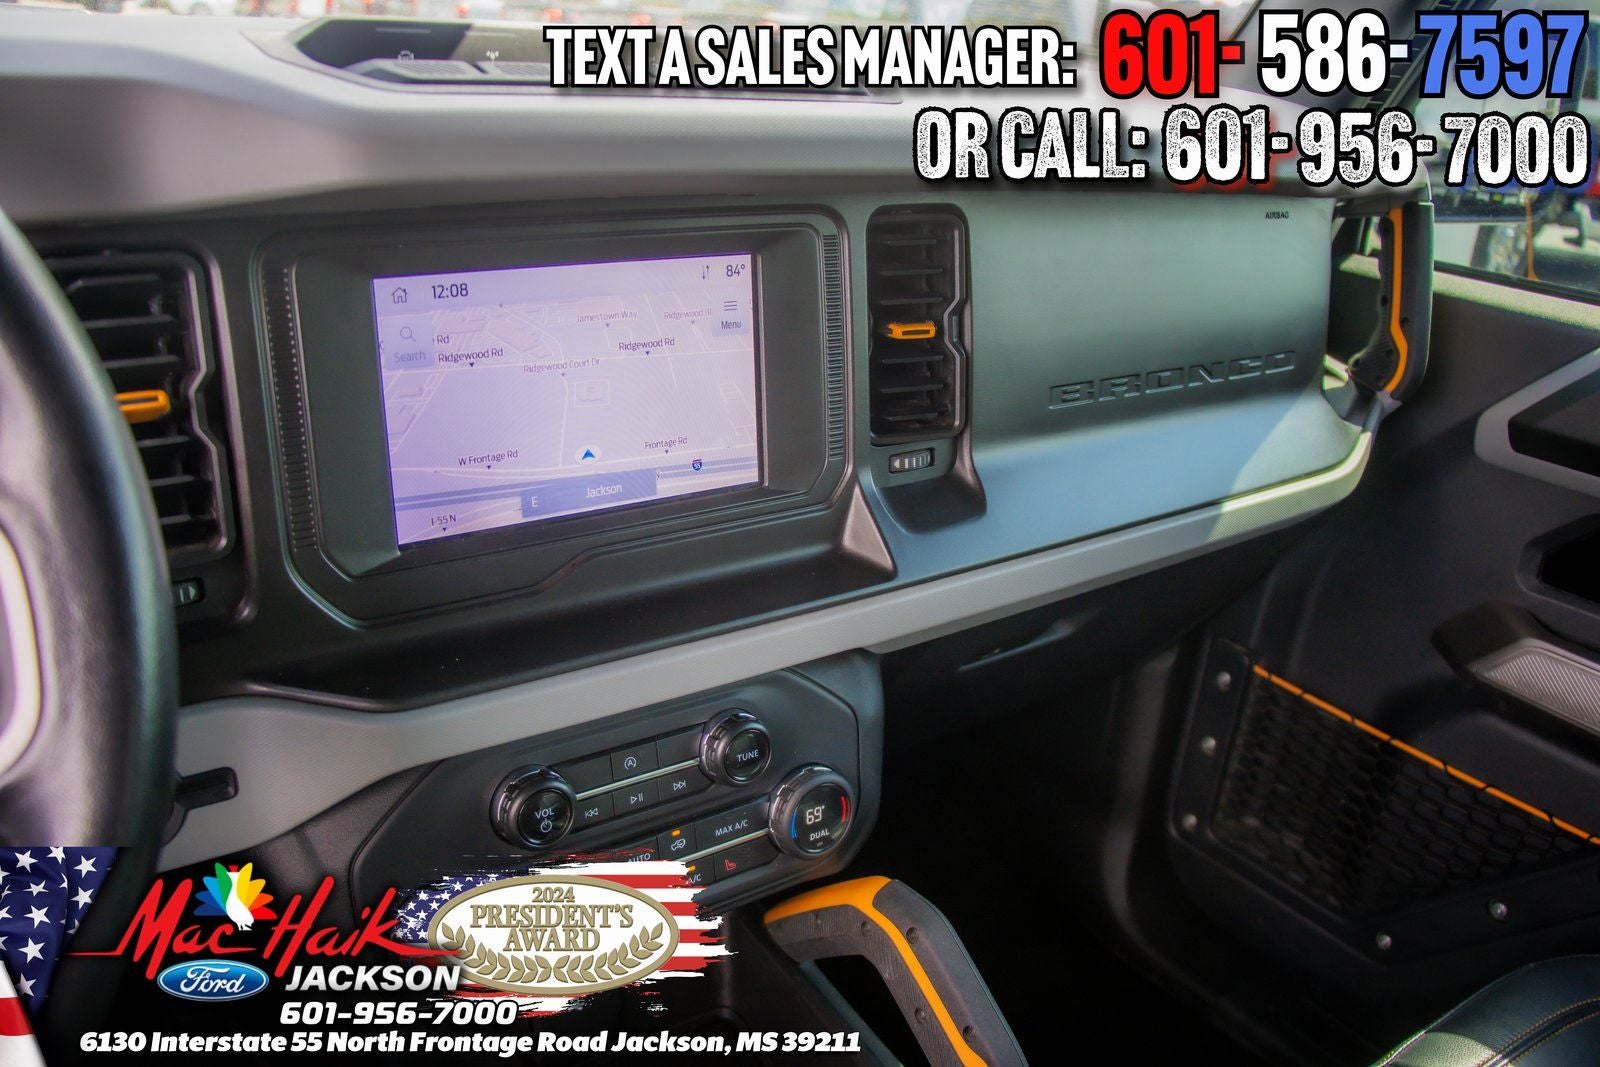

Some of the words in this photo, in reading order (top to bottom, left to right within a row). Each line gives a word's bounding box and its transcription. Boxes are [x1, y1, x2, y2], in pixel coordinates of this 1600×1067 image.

[1264, 210, 1290, 220] AIRBAG
[431, 282, 469, 300] 12:08
[621, 309, 637, 321] Way
[721, 319, 742, 330] Menu
[436, 334, 450, 345] Rd
[618, 339, 663, 351] Ridgewood
[664, 337, 675, 346] Rd
[394, 351, 426, 362] Search
[438, 349, 490, 363] Ridgewood
[491, 347, 504, 357] Rd
[569, 359, 590, 369] Court
[591, 357, 600, 367] Dr
[1049, 350, 1296, 409] BRONCO
[644, 438, 677, 449] Frontage
[678, 436, 688, 446] Rd
[458, 457, 467, 467] W
[468, 452, 506, 465] Frontage
[507, 448, 518, 459] Rd
[531, 496, 538, 507] E
[586, 483, 623, 498] Jackson
[449, 514, 457, 523] N
[736, 749, 759, 763] TUNE
[535, 808, 556, 819] VOL
[715, 825, 733, 836] MAX
[734, 820, 749, 830] A/C
[810, 829, 830, 841] DUAL
